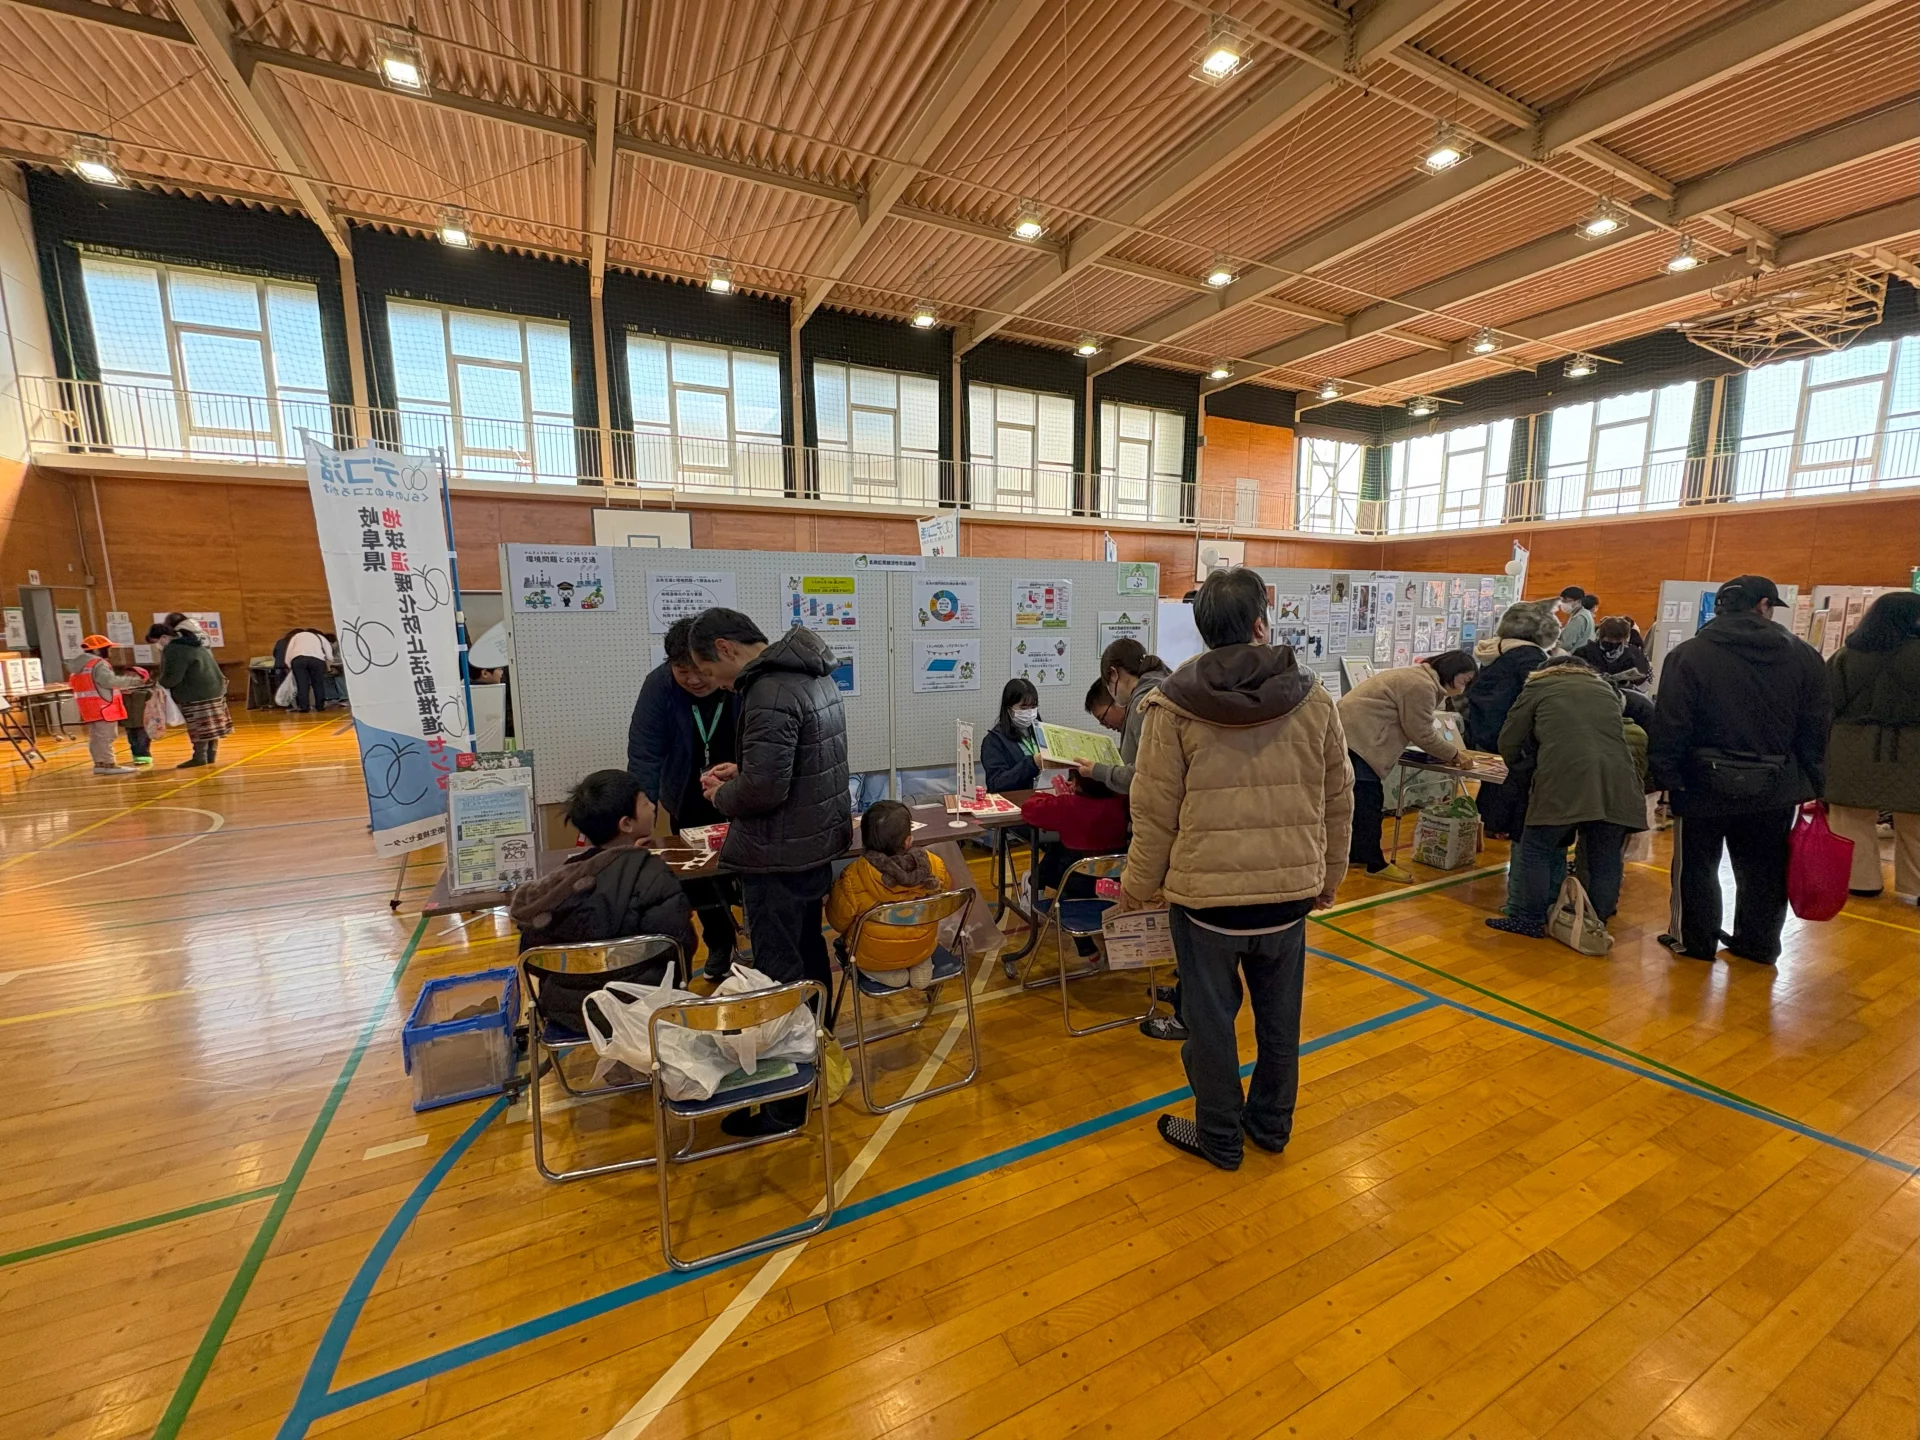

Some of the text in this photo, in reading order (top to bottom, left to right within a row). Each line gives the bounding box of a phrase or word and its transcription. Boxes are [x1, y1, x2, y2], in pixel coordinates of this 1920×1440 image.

[525, 555, 597, 564] 環境問題と公共交通
